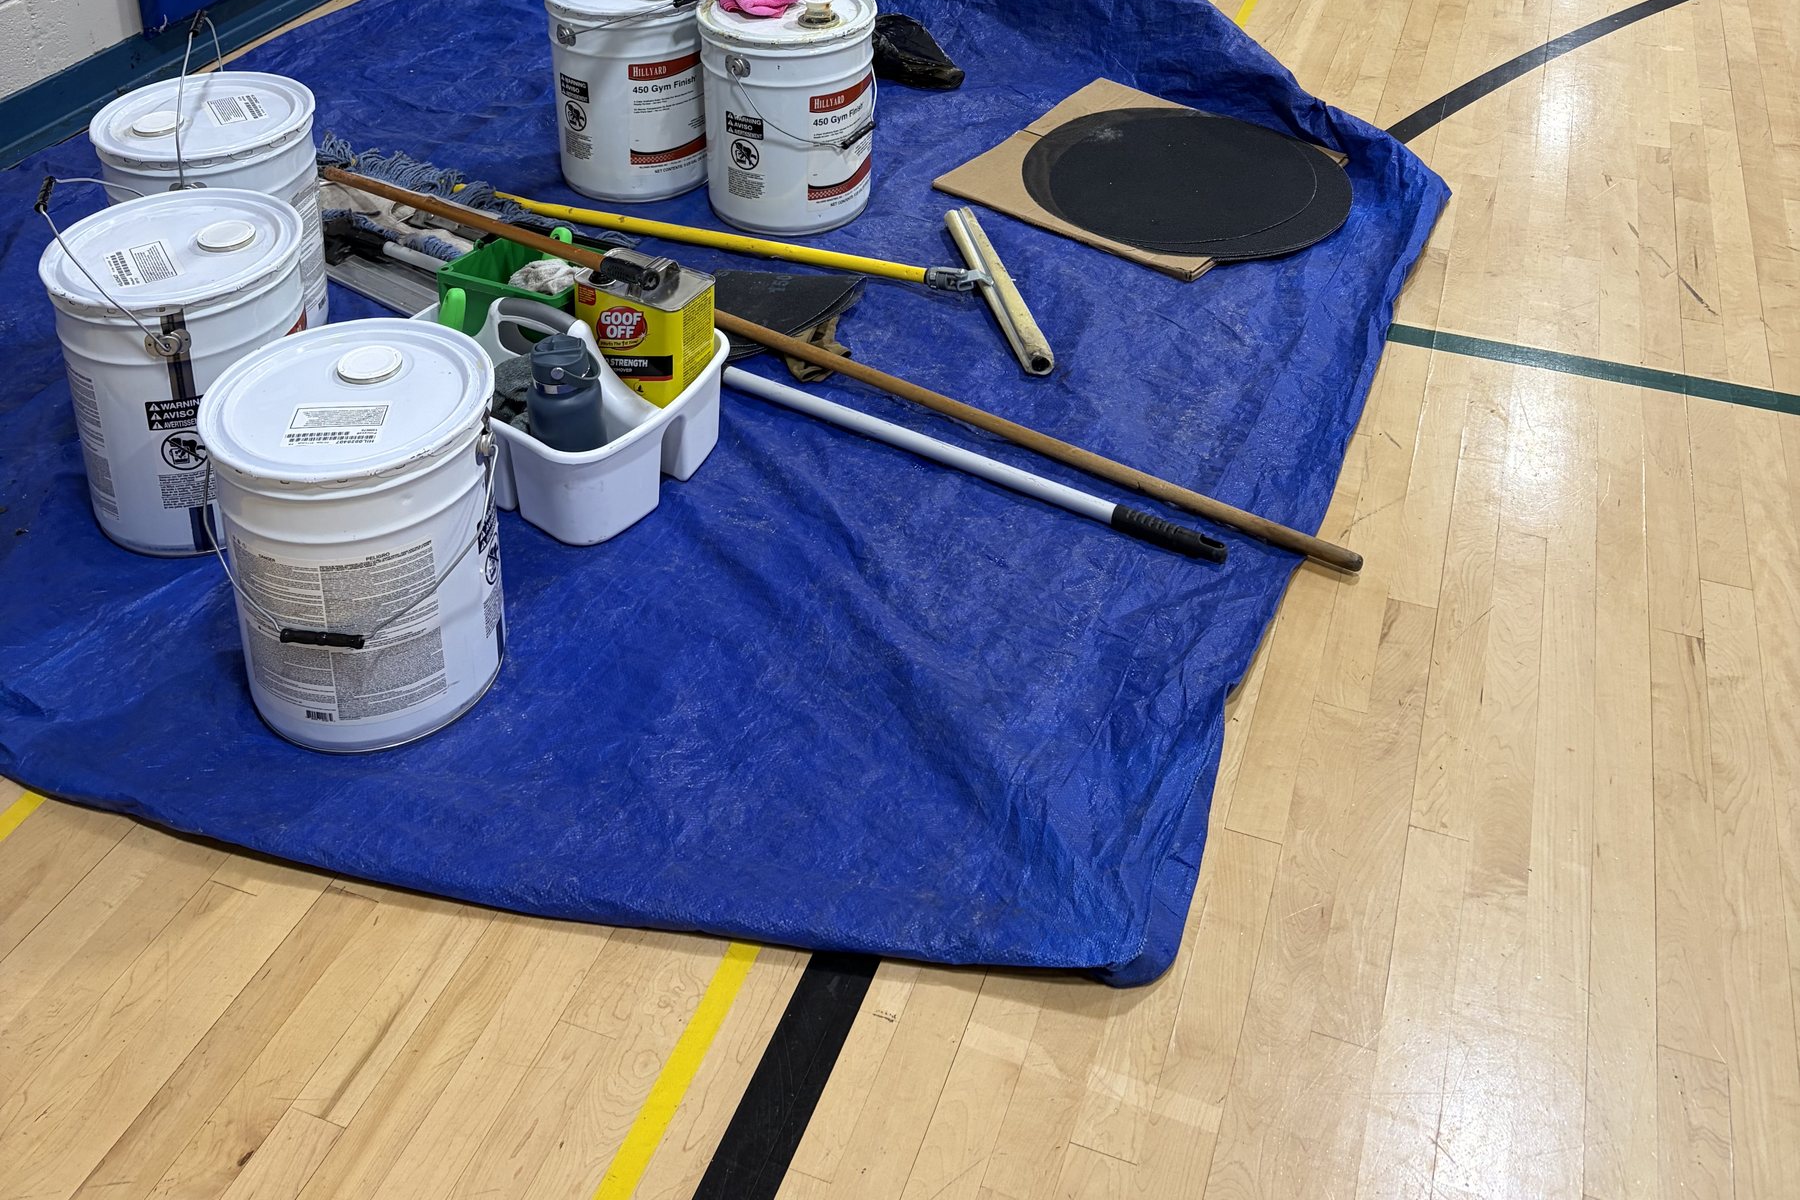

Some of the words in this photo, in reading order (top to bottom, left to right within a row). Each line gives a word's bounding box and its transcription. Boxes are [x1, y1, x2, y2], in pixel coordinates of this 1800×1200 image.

[632, 65, 667, 77] HILLYARD
[632, 85, 649, 94] 450
[651, 83, 672, 94] Gym
[814, 95, 845, 109] HILLYARD
[734, 114, 762, 126] WARNING
[813, 117, 829, 127] 450
[830, 113, 848, 124] Gym
[734, 122, 753, 131] AVISO
[601, 312, 642, 326] GOOF
[606, 325, 636, 339] OFF
[609, 358, 649, 368] STRENGTH
[160, 398, 201, 410] WARNIN
[163, 409, 194, 420] AVISO
[365, 551, 391, 561] PELIGRO
